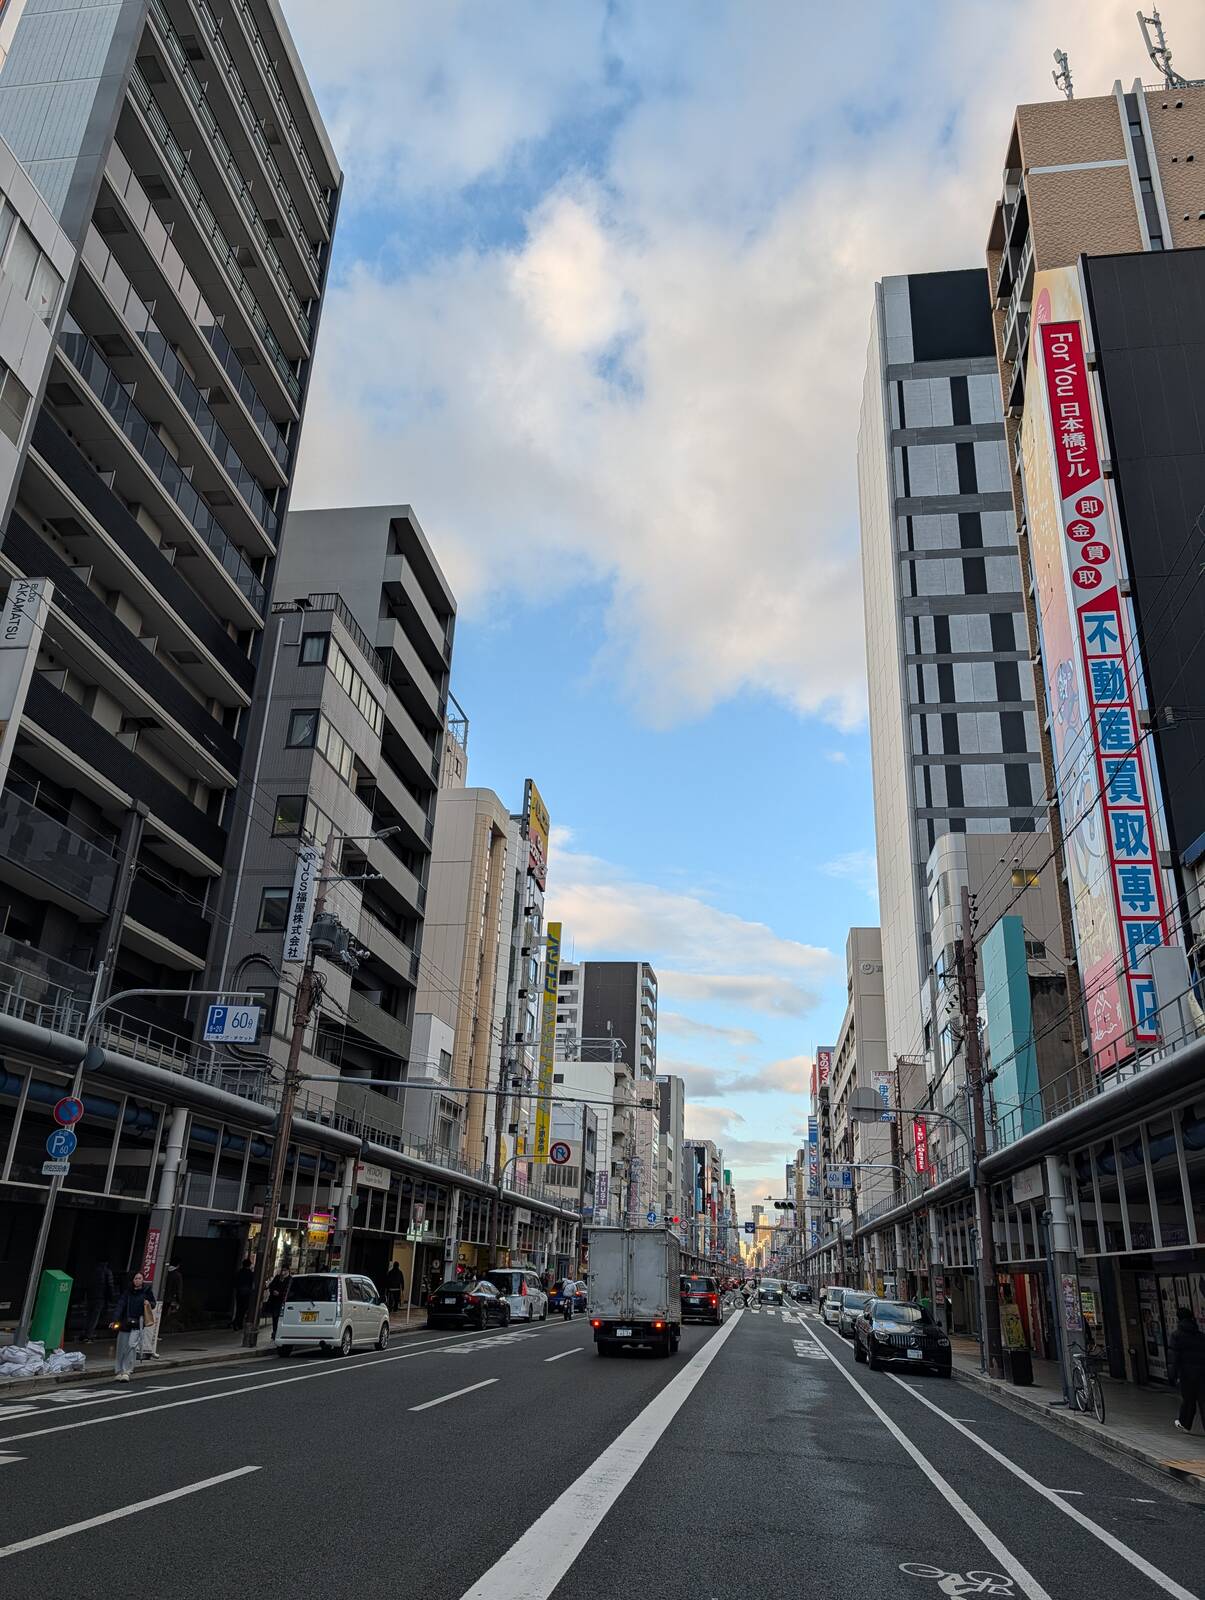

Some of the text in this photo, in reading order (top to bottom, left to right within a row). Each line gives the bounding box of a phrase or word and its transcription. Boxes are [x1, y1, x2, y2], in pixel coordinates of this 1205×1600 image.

[1050, 333, 1091, 478] For You 日本橋ビル
[1071, 500, 1106, 585] 即金買取
[5, 583, 29, 640] AKAMATSU
[212, 1008, 223, 1025] P
[51, 1136, 65, 1153] P
